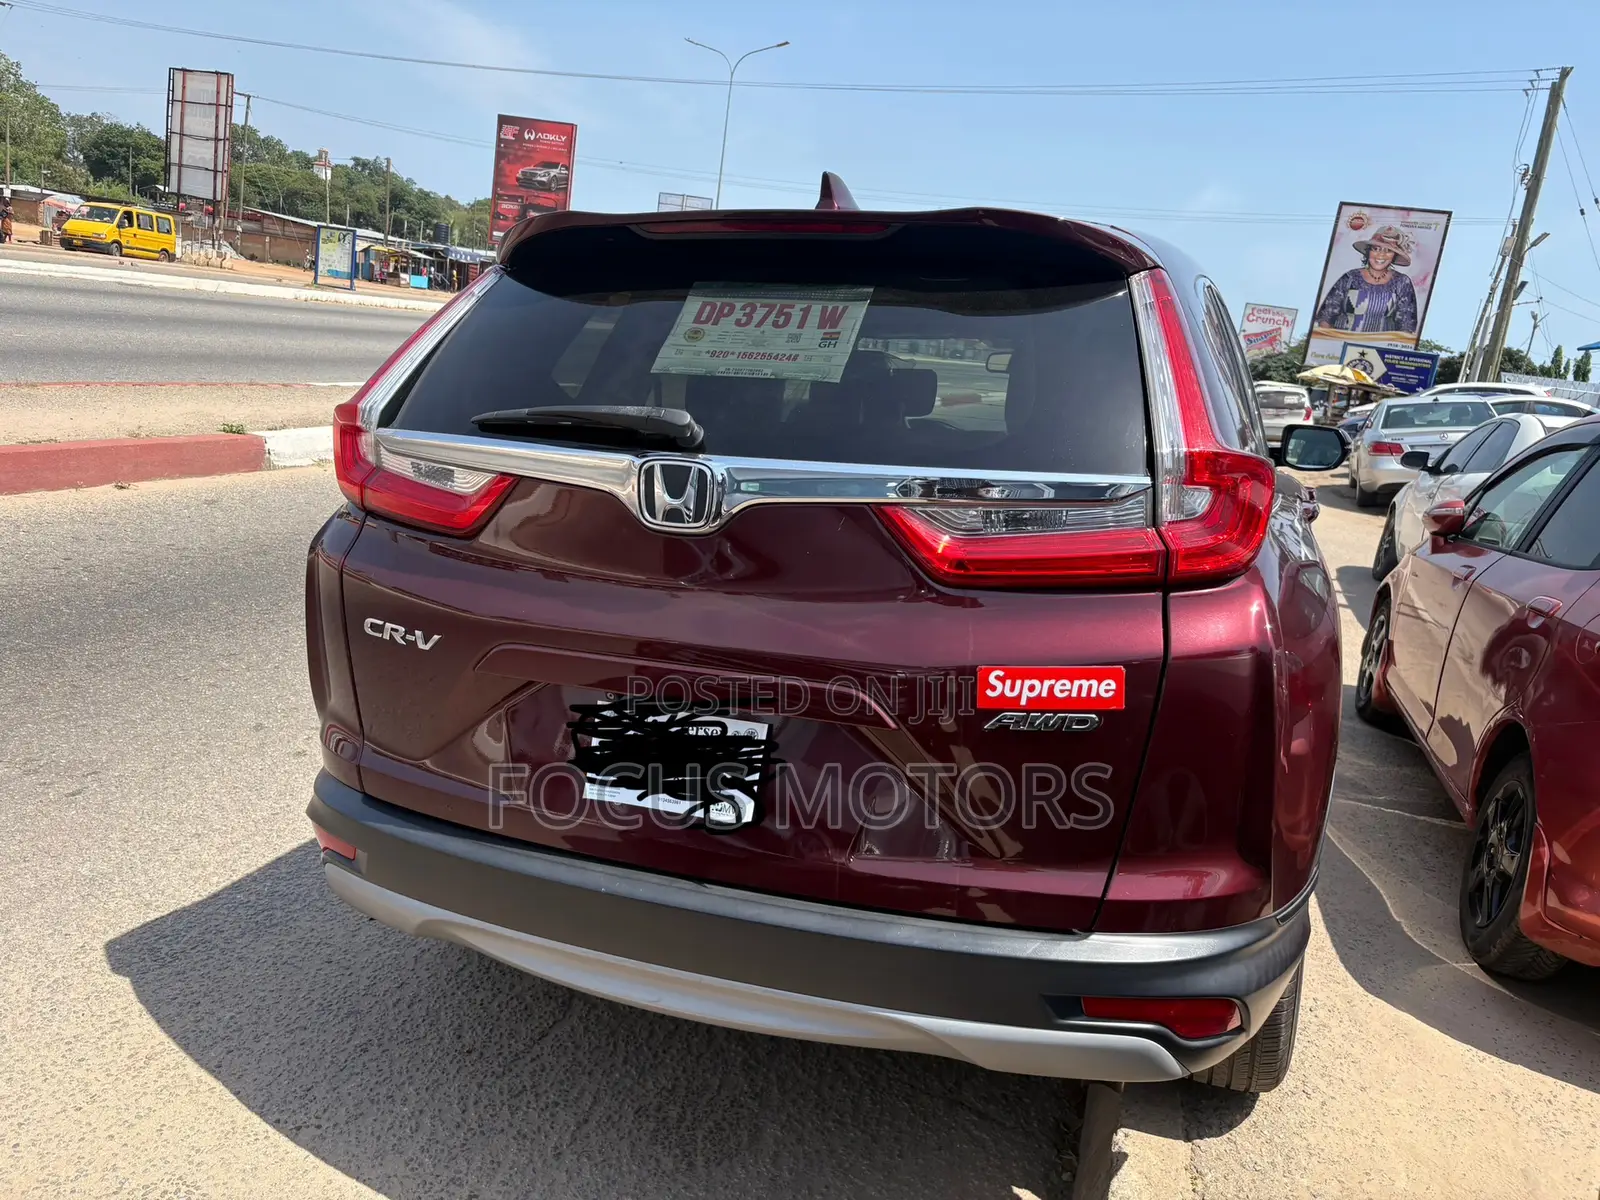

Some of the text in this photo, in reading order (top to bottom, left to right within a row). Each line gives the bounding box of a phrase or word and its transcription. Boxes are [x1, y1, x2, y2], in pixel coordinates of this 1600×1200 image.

[692, 301, 850, 330] DP 3751 W
[818, 341, 838, 349] GH
[363, 617, 443, 651] CR-V
[985, 669, 1117, 706] Supreme
[983, 711, 1099, 732] AWD
